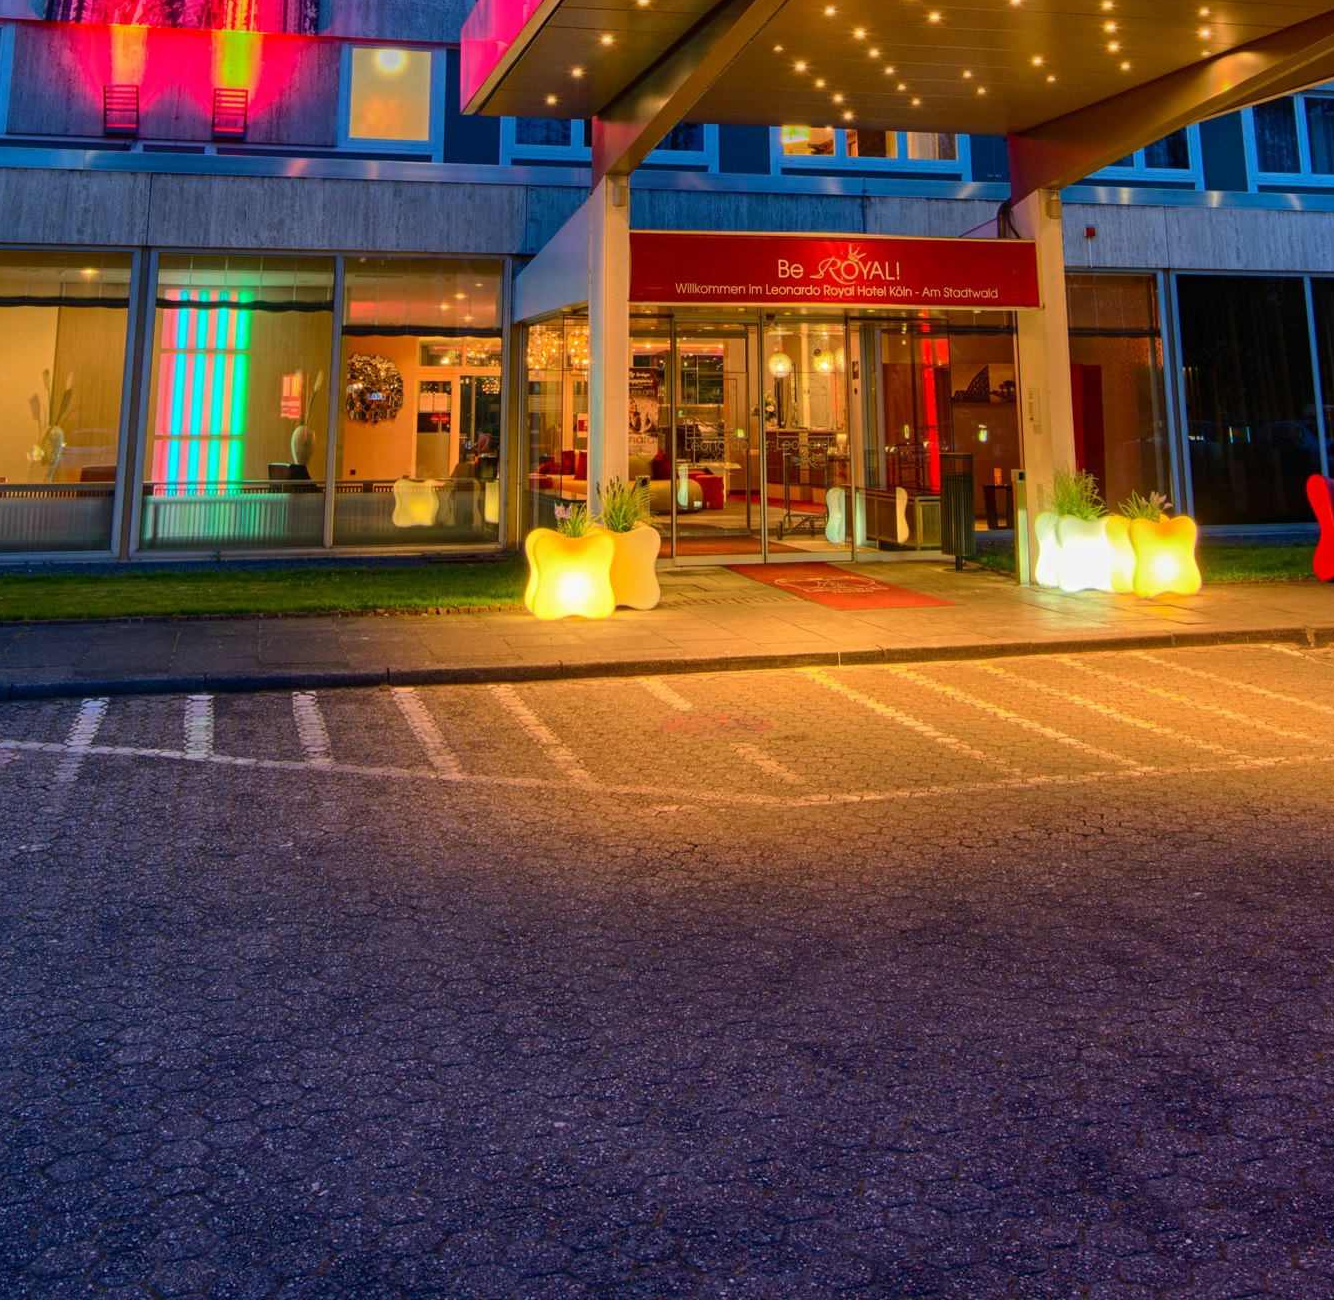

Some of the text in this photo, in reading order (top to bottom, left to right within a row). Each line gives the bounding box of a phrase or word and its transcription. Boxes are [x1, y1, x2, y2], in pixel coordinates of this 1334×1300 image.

[778, 255, 900, 285] Be ROYAL!
[675, 282, 746, 295] Willkommen
[748, 283, 763, 295] im
[766, 284, 821, 296] Leonardo
[823, 284, 855, 299] Royal
[857, 285, 887, 297] Hotel
[889, 285, 913, 298] Köln
[921, 286, 942, 298] Am
[943, 286, 999, 299] Stadtwald
